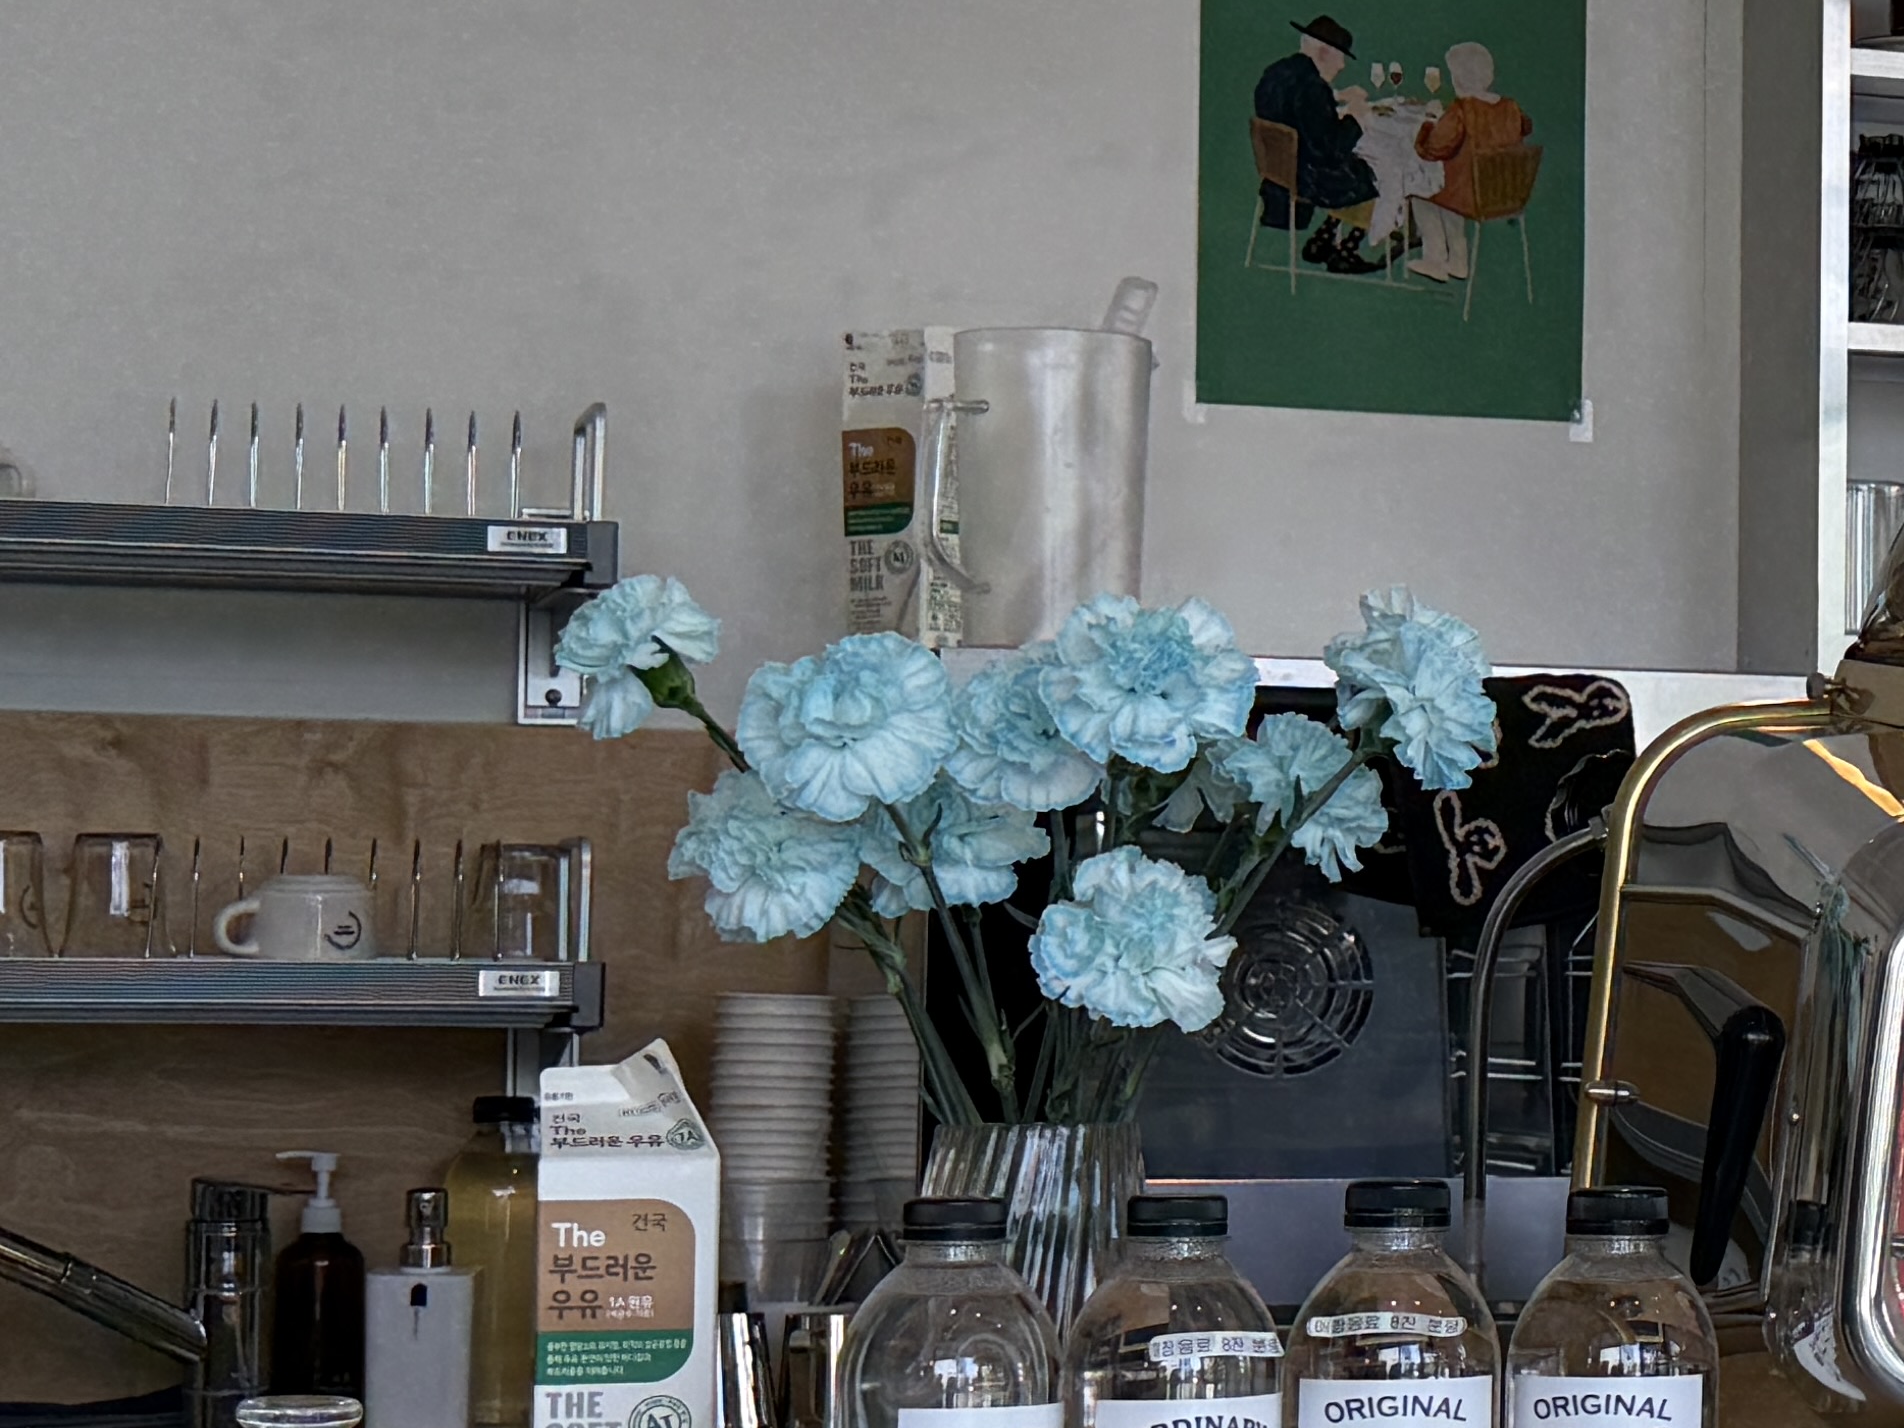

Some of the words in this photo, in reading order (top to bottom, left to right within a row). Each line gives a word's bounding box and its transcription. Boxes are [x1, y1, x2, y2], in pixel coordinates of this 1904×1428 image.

[849, 442, 874, 458] The
[850, 540, 874, 556] THE
[850, 556, 882, 573] SOFT
[850, 574, 884, 592] MILK
[550, 1125, 587, 1136] The
[551, 1135, 623, 1149] 부드러운
[626, 1134, 665, 1148] 우유
[632, 1212, 668, 1232] 건국
[551, 1222, 606, 1248] The
[549, 1253, 656, 1284] 부드러운
[548, 1289, 603, 1320] 우유
[545, 1391, 603, 1419] THE
[1324, 1395, 1467, 1423] ORIGINAL
[1533, 1394, 1672, 1422] ORIGINAL
